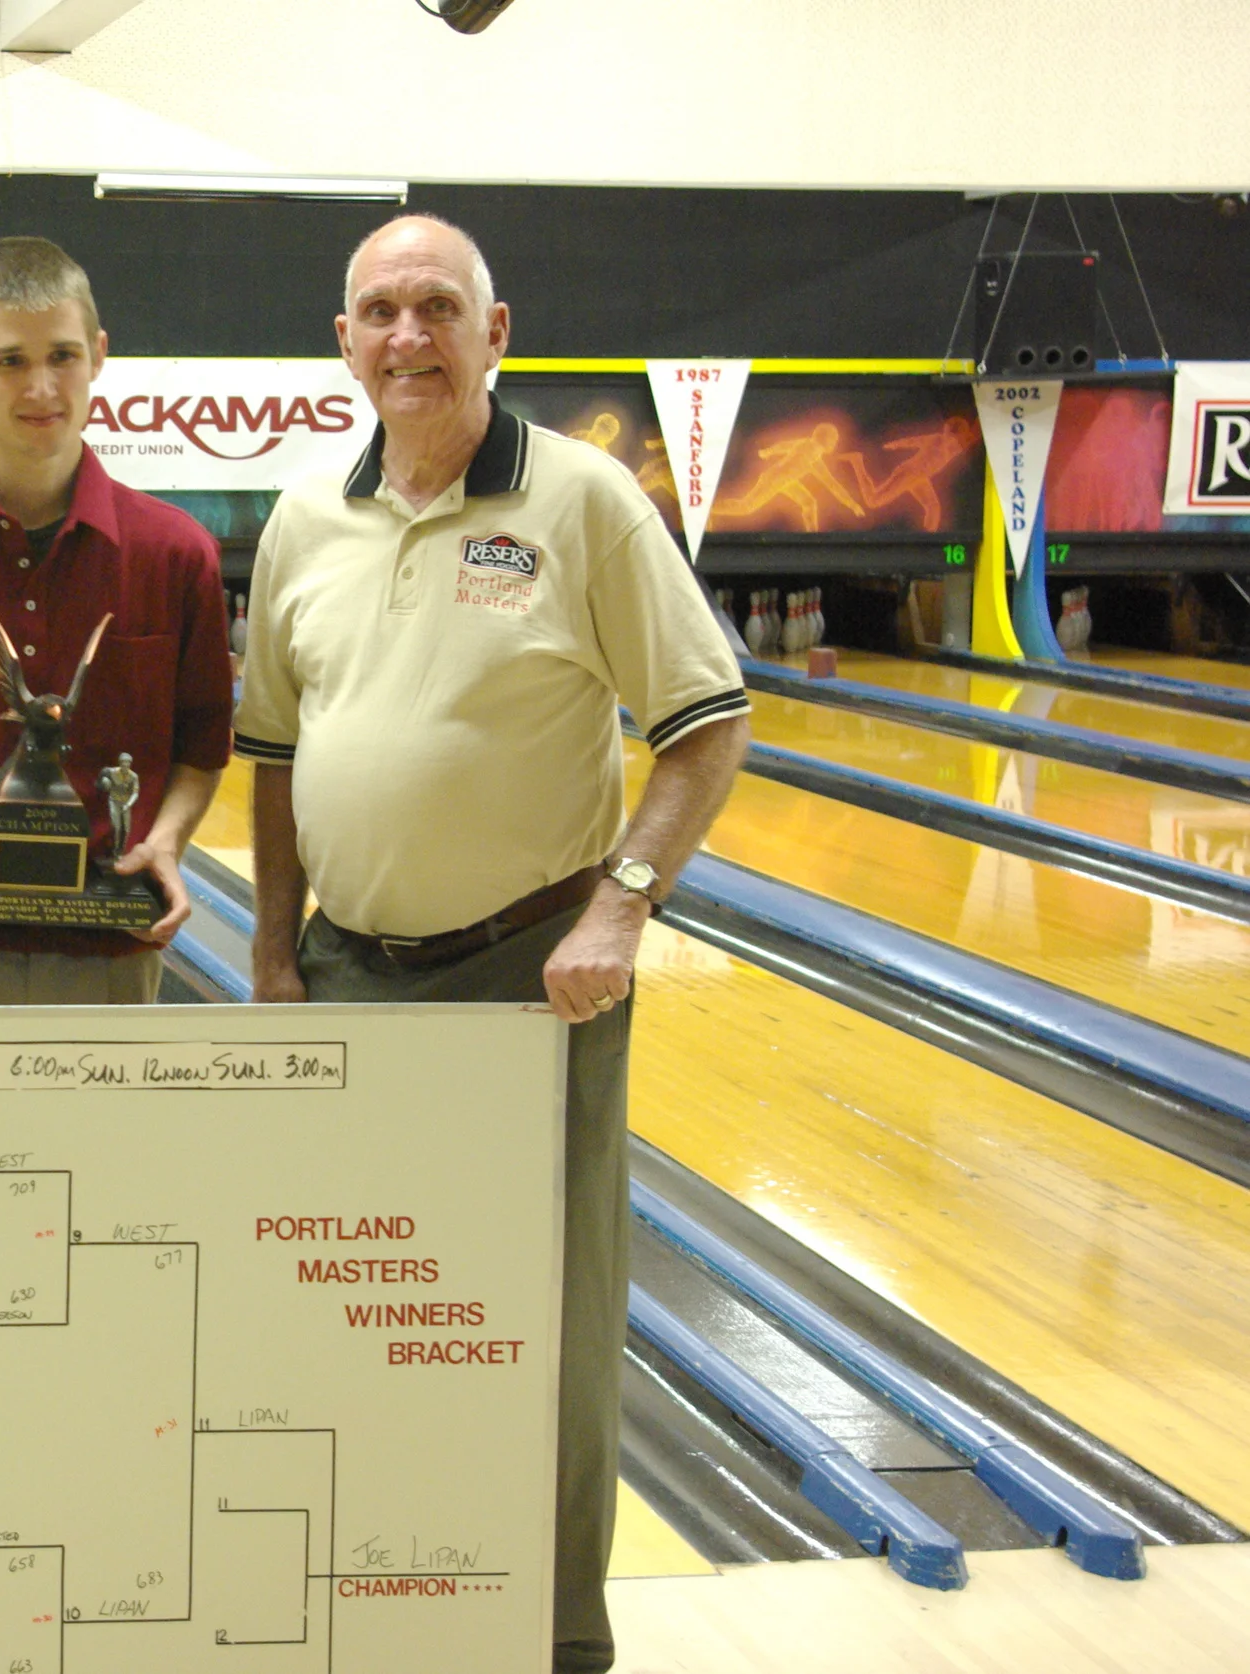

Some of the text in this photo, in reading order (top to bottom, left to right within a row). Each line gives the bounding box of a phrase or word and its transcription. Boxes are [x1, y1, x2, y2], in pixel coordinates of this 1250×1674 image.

[675, 368, 721, 383] 1987
[995, 387, 1040, 400] 2002
[82, 395, 354, 446] ACKAMAS
[91, 445, 183, 455] REDIT UNION
[688, 388, 703, 507] STANFORD
[1011, 406, 1026, 531] COPELAND
[943, 545, 966, 564] 16
[1047, 545, 1070, 563] 17
[456, 570, 534, 597] Portland
[454, 588, 530, 613] Masters
[112, 1222, 179, 1242] WEST
[255, 1216, 415, 1241] PORTLAND
[297, 1258, 439, 1283] MASTERS
[344, 1301, 485, 1327] WINNERS
[387, 1339, 525, 1364] BRACKET
[199, 1407, 289, 1431] 11 LIPAN
[218, 1496, 228, 1509] 11
[351, 1534, 482, 1573] JOE LIPAN
[65, 1570, 165, 1621] 10 LIPAN 683
[338, 1577, 456, 1598] CHAMPION
[215, 1629, 228, 1642] 12
